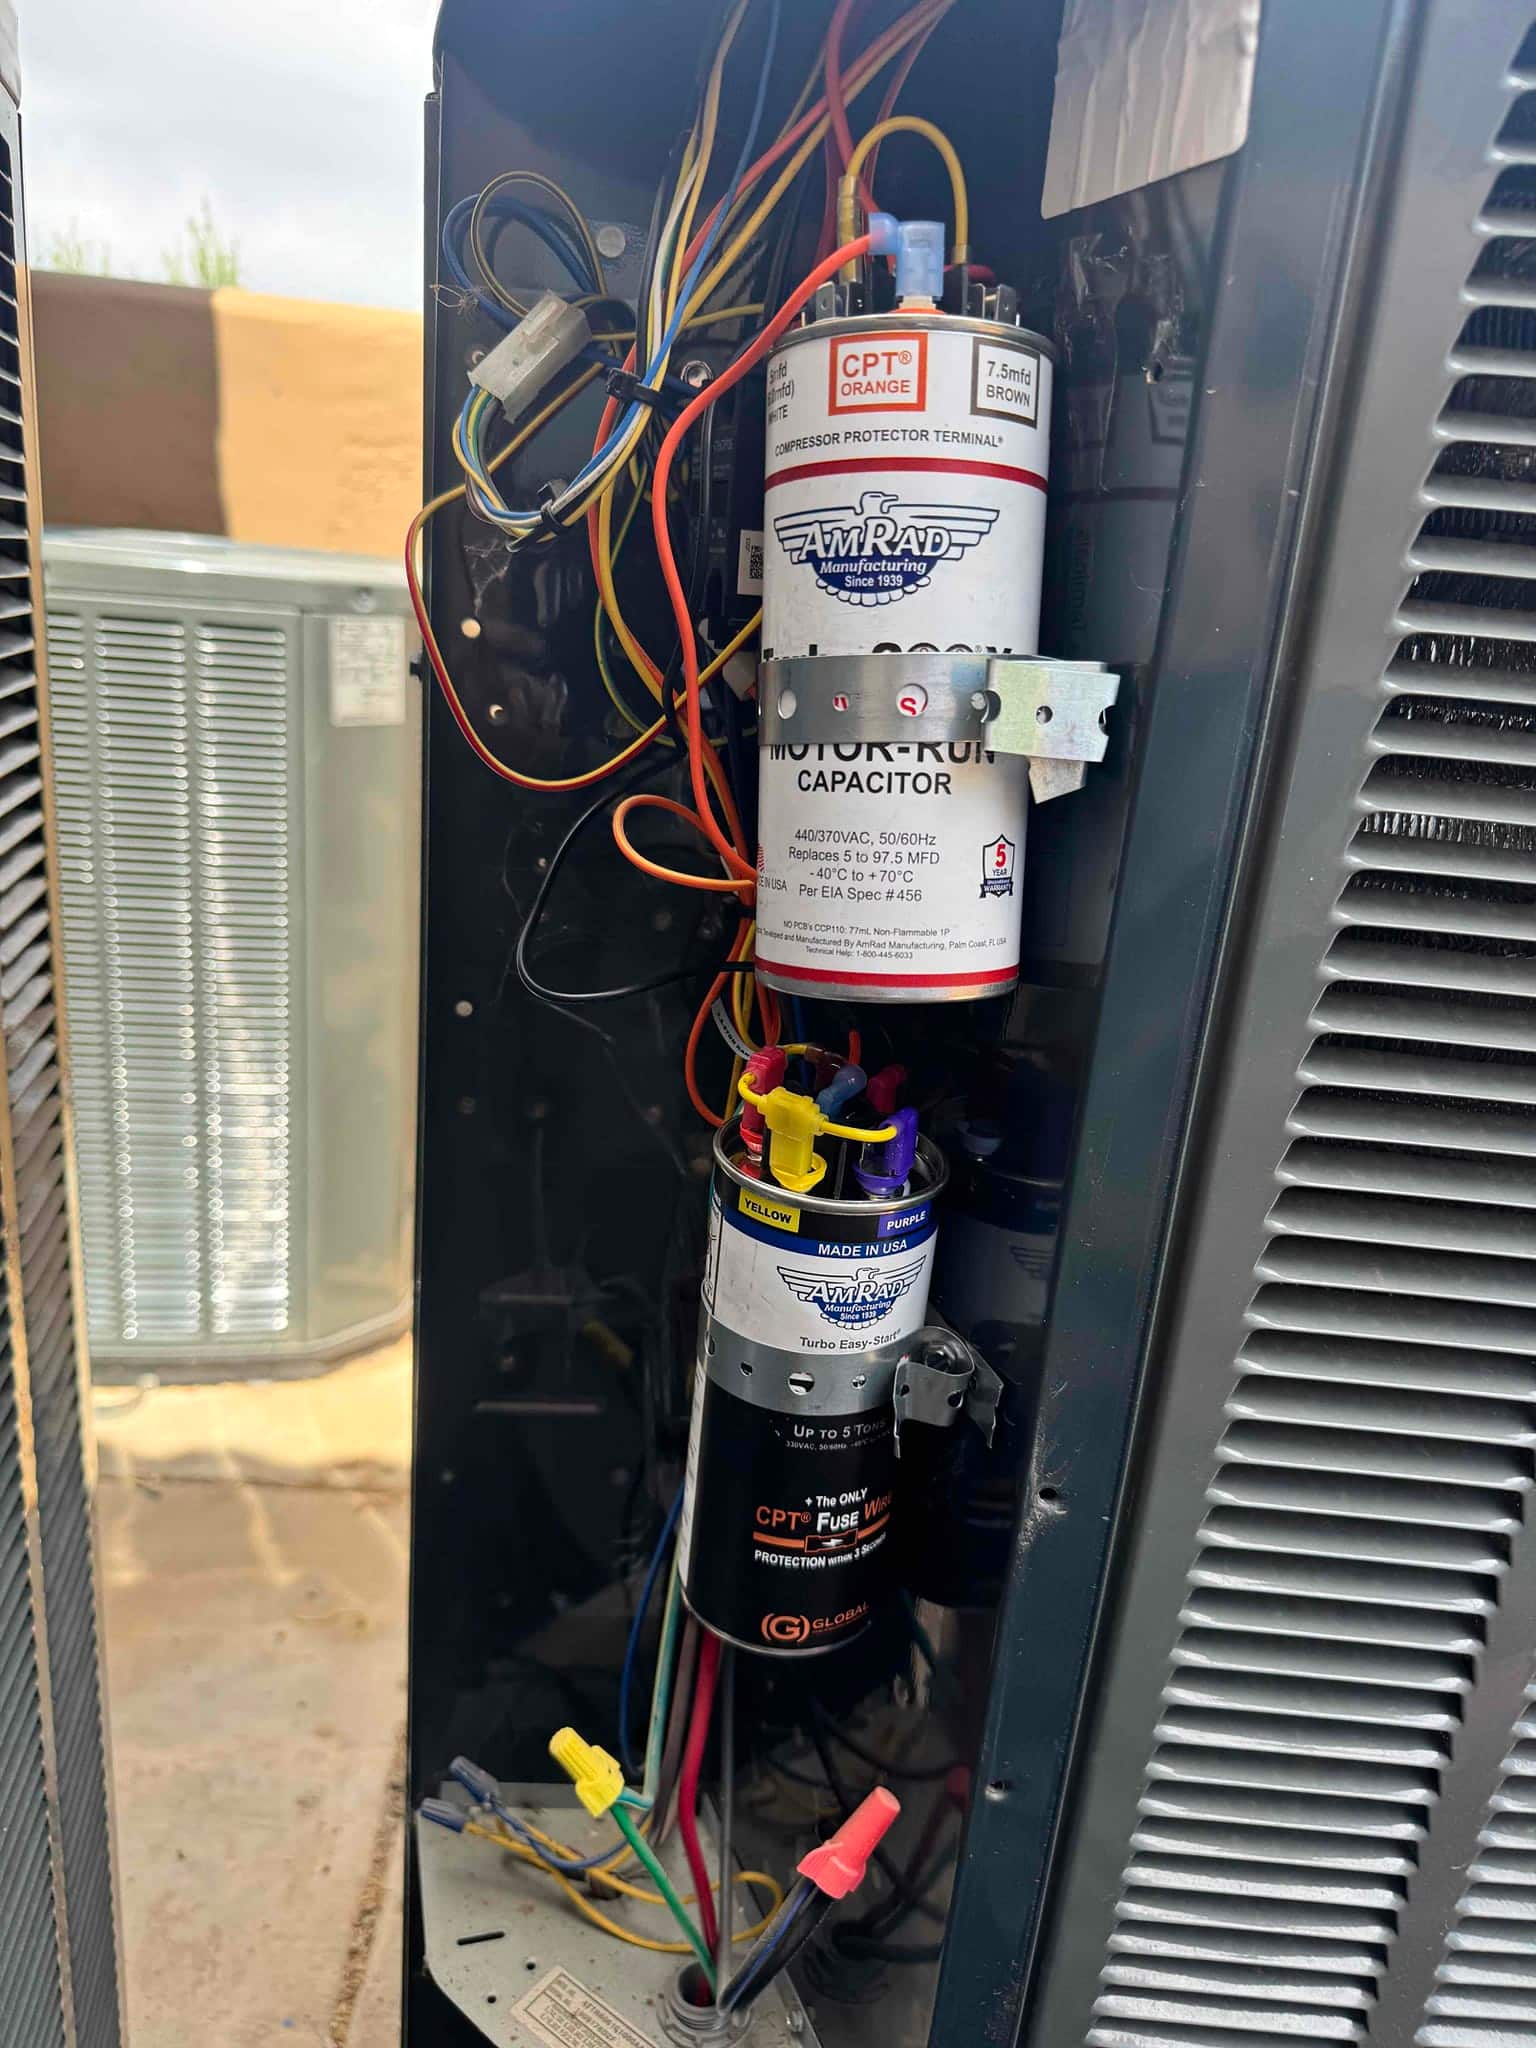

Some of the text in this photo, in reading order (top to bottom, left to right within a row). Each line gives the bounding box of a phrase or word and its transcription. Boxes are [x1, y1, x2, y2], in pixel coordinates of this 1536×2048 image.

[987, 361, 1032, 386] 7.5mfd
[841, 379, 911, 397] ORANGE
[986, 384, 1031, 407] BROWN
[775, 432, 840, 457] COMPRESSOR
[844, 429, 929, 444] PROTECTOR
[820, 558, 928, 576] Manufacturing
[844, 575, 903, 588] Since 1939
[797, 769, 953, 796] CAPACITOR
[794, 828, 937, 847] 440/370VAC, 50/60Hz
[788, 846, 940, 866] Replaces 5 to 97.5 MFD
[995, 843, 1006, 868] 5
[851, 868, 864, 881] to
[799, 884, 818, 897] Per
[821, 886, 843, 899] EIA
[846, 888, 881, 904] Spec
[744, 1198, 793, 1225] YELLOW
[886, 1209, 926, 1231] PURPLE
[818, 1239, 908, 1257] MADE IN USA
[824, 1300, 892, 1314] Manufacturing
[840, 1310, 877, 1321] Since 1939
[799, 1336, 836, 1350] Turbo
[842, 1425, 851, 1438] 5
[816, 1495, 837, 1508] The
[839, 1487, 868, 1505] ONLY
[754, 1549, 827, 1570] PROTECTION
[854, 1548, 860, 1560] 3
[811, 1601, 870, 1630] GLOBAL
